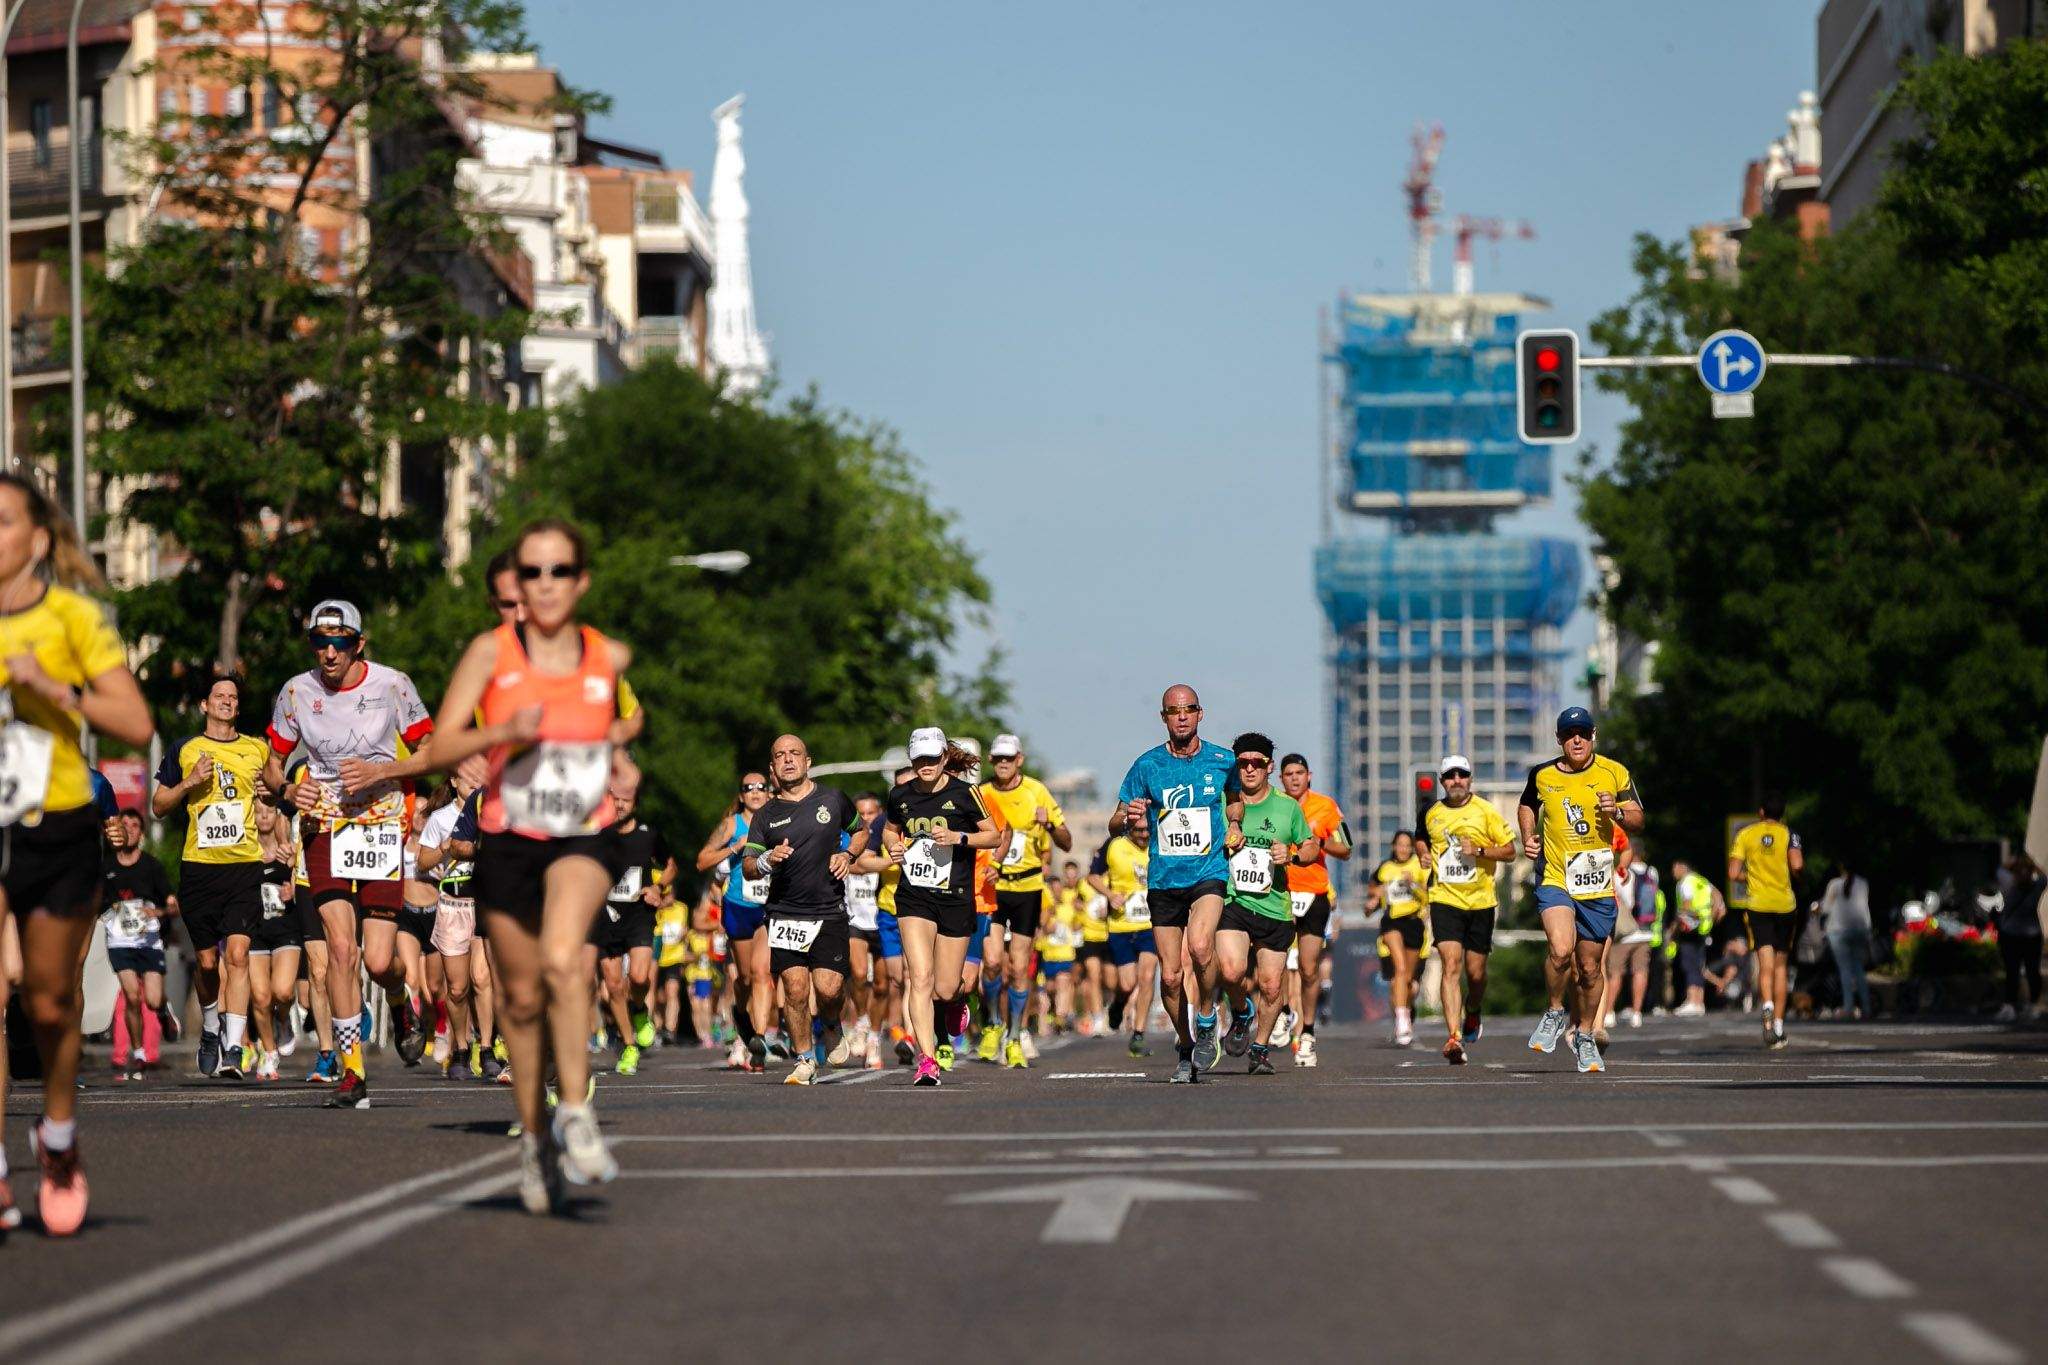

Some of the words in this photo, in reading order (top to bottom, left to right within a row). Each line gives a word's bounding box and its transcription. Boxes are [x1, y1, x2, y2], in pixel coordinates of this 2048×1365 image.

[769, 817, 792, 829] hummel
[906, 815, 948, 835] 100
[1577, 823, 1588, 832] 13
[206, 824, 238, 840] 3280
[378, 833, 397, 846] 6379
[1167, 832, 1201, 847] 1504
[1235, 869, 1265, 885] 1804
[1574, 871, 1605, 887] 3553
